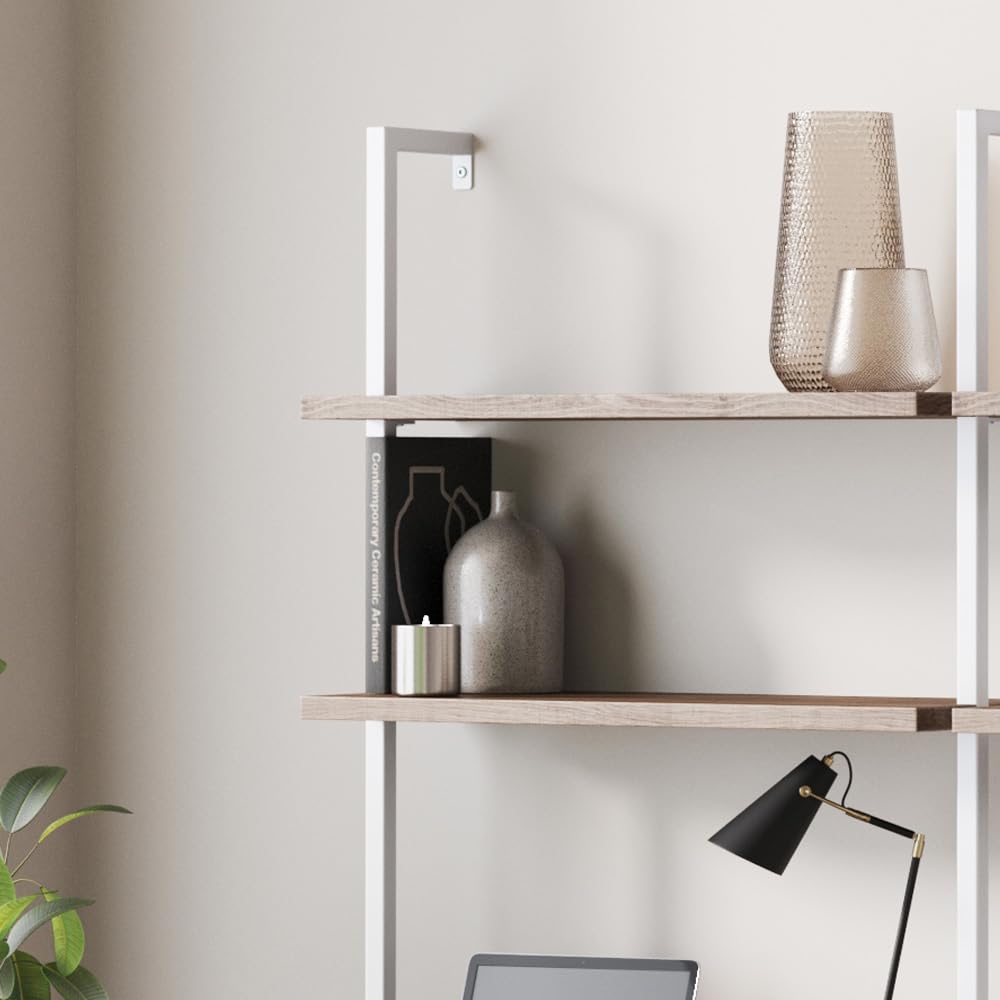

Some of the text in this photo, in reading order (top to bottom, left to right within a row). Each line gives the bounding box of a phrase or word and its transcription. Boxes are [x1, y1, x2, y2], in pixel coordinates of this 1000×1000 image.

[370, 452, 381, 663] Contemporary Ceramic Artisans
